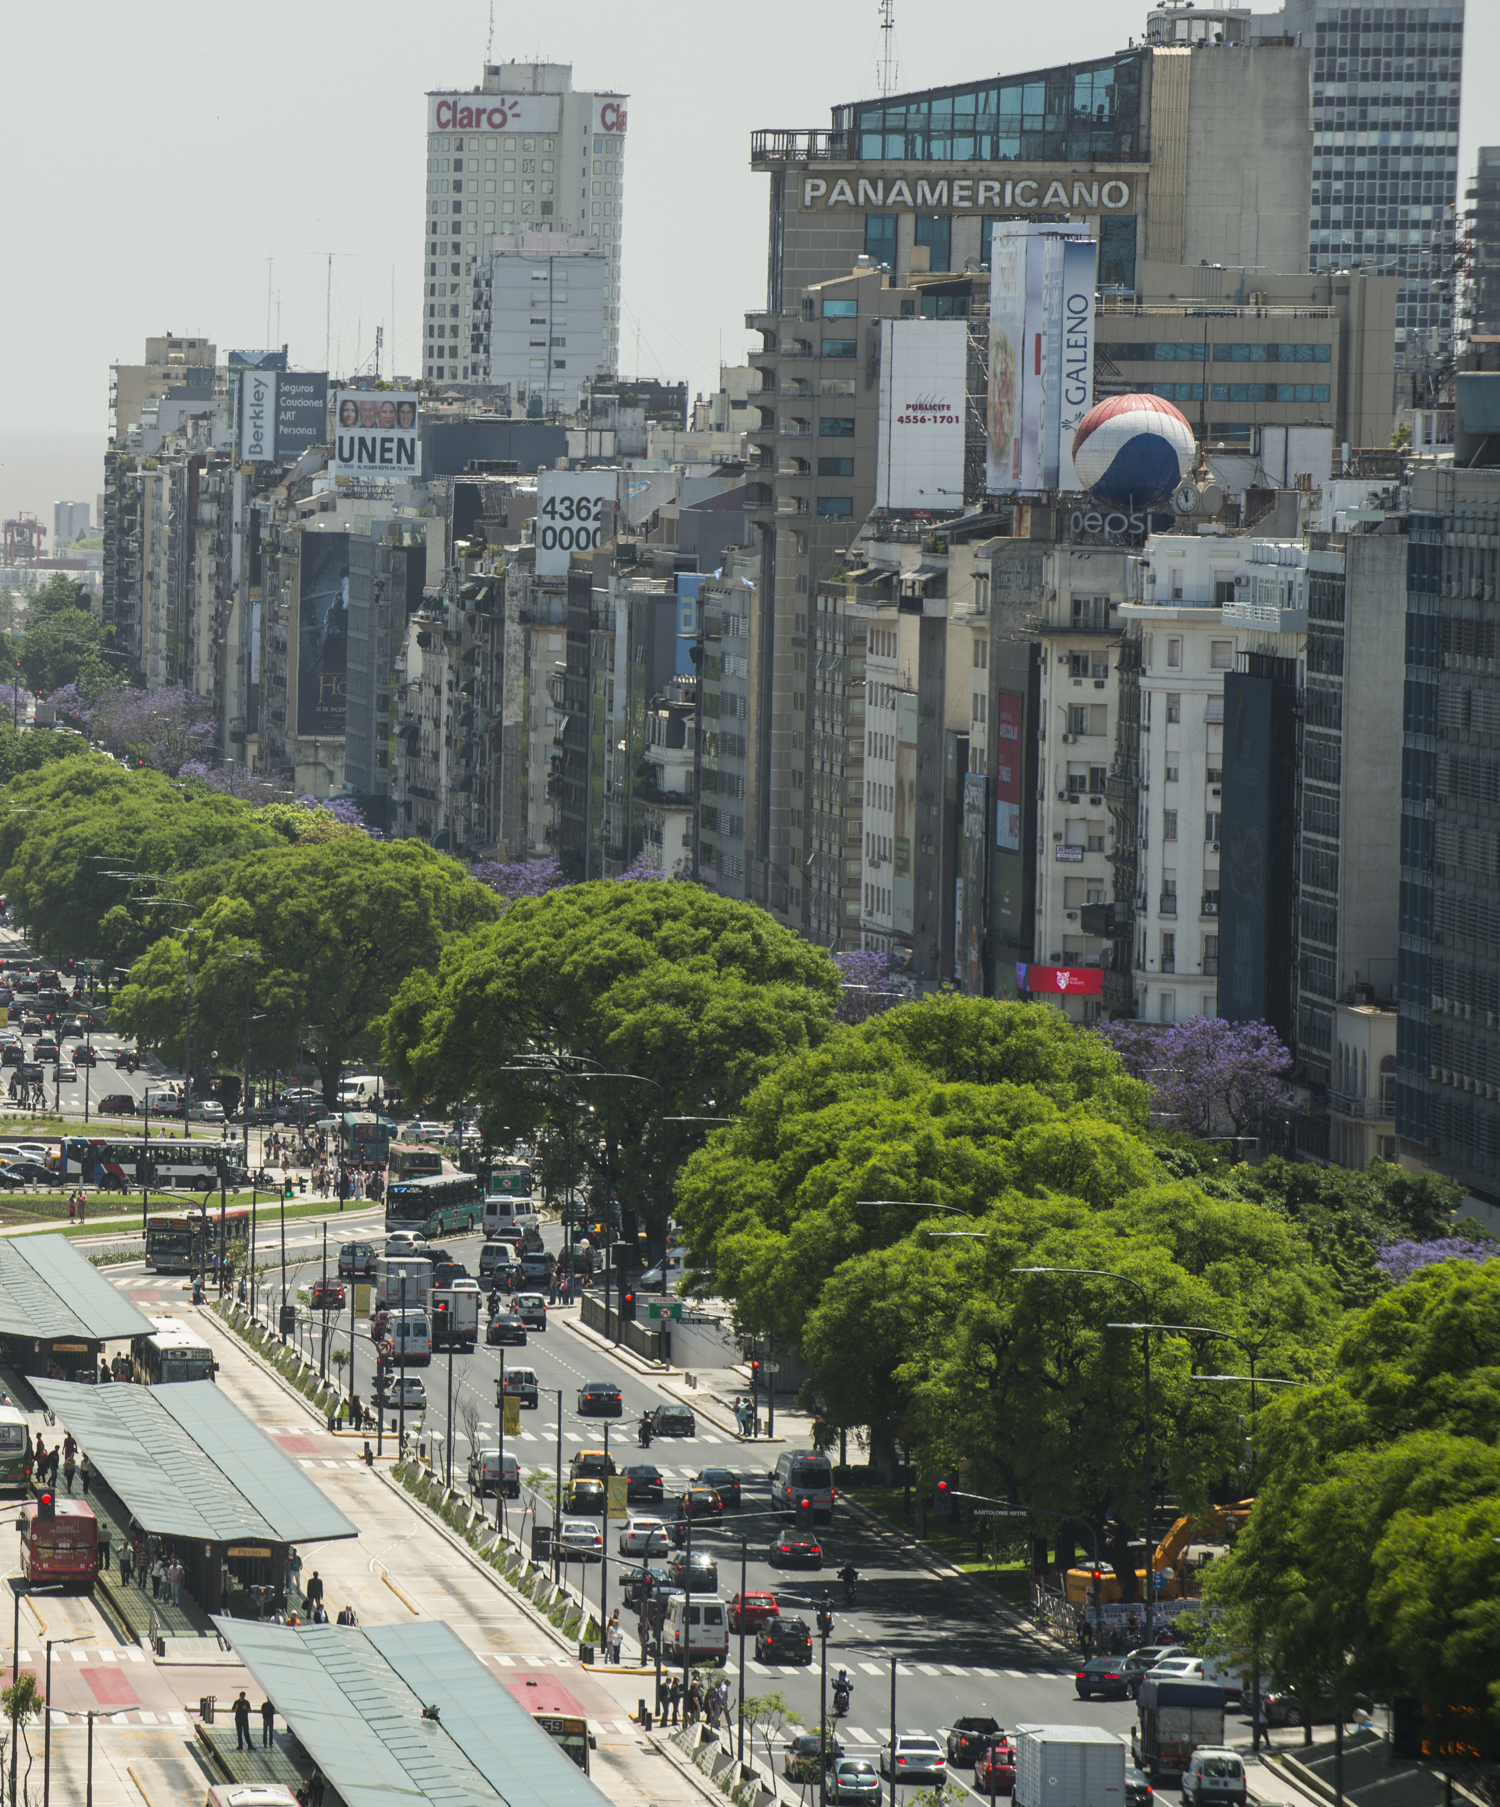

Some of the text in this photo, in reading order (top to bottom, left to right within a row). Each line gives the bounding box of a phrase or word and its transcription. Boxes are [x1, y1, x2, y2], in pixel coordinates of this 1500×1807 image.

[436, 100, 508, 130] Claro
[803, 178, 1130, 209] PANAMERICANO
[1065, 293, 1089, 406] GALENO
[280, 382, 314, 394] Seguros
[280, 397, 324, 407] Cauciones
[906, 403, 952, 411] PUBLICITE
[248, 377, 269, 455] Berkley
[279, 411, 296, 421] ART
[897, 415, 960, 424] 4556-1701
[279, 425, 317, 435] Personas
[338, 435, 416, 465] UNEN
[1070, 507, 1153, 541] pepsi
[169, 1350, 188, 1358] 9
[541, 1720, 563, 1731] 59
